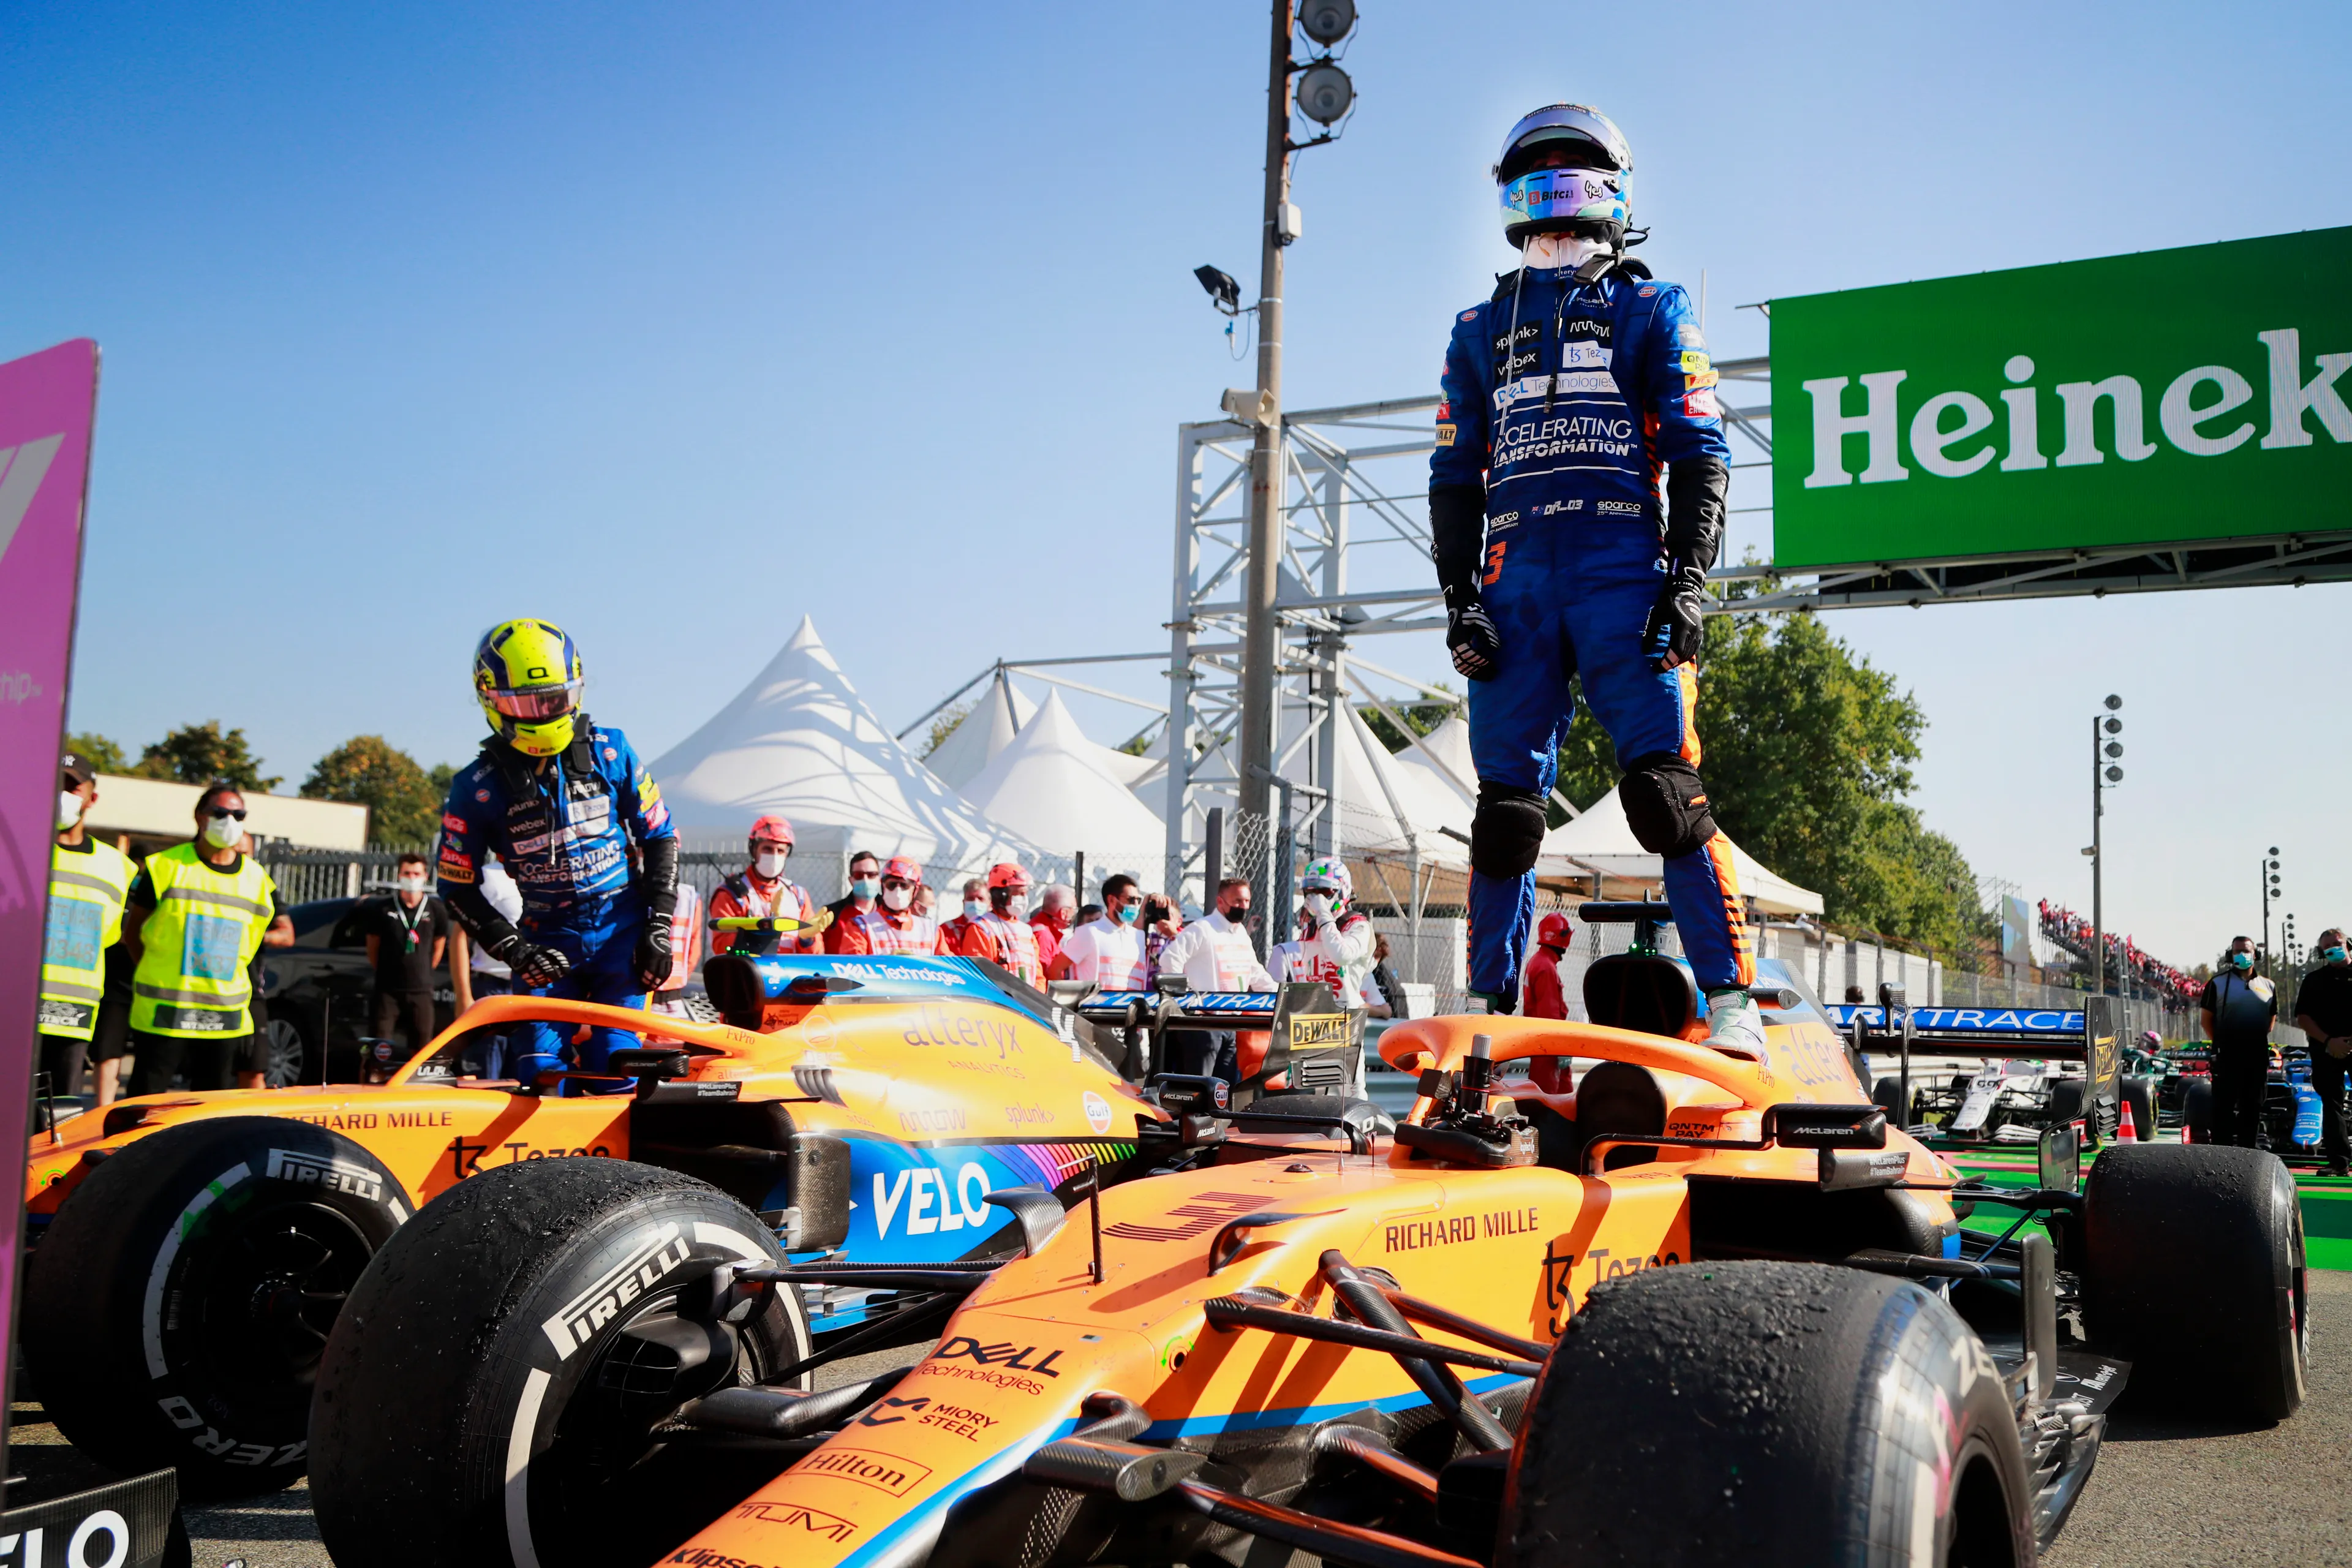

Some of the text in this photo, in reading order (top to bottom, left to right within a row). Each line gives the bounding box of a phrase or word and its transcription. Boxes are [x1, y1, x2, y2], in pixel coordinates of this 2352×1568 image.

[1496, 326, 1539, 350] splnk>
[1597, 500, 1641, 511] sparco
[1491, 511, 1519, 526] sparco
[509, 818, 546, 834] webex
[831, 962, 967, 986] DELL Technologies
[726, 1027, 755, 1045] FxPro
[903, 1005, 1023, 1060] alteryx
[1294, 1020, 1345, 1042] DeWALT
[948, 1060, 1025, 1079] ANALYTICS
[1757, 1065, 1775, 1088] FxPro
[1163, 1093, 1193, 1101] McLaren
[1215, 1090, 1228, 1101] Gulf
[387, 1111, 453, 1128] MILLE
[1086, 1104, 1110, 1120] Gulf
[1668, 1123, 1714, 1133] QNTM
[1793, 1126, 1855, 1136] McLaren
[266, 1148, 383, 1202] PIRELLI
[872, 1161, 991, 1240] VELO
[1385, 1207, 1539, 1254] RICHARD MILLE
[541, 1221, 691, 1361] PIRELLI
[930, 1336, 1065, 1378] DELL
[914, 1362, 1045, 1396] Technologies
[932, 1404, 1000, 1429] MIORY
[918, 1415, 980, 1442] STEEL
[803, 1453, 906, 1487] Hilton
[736, 1502, 859, 1543] TUMI
